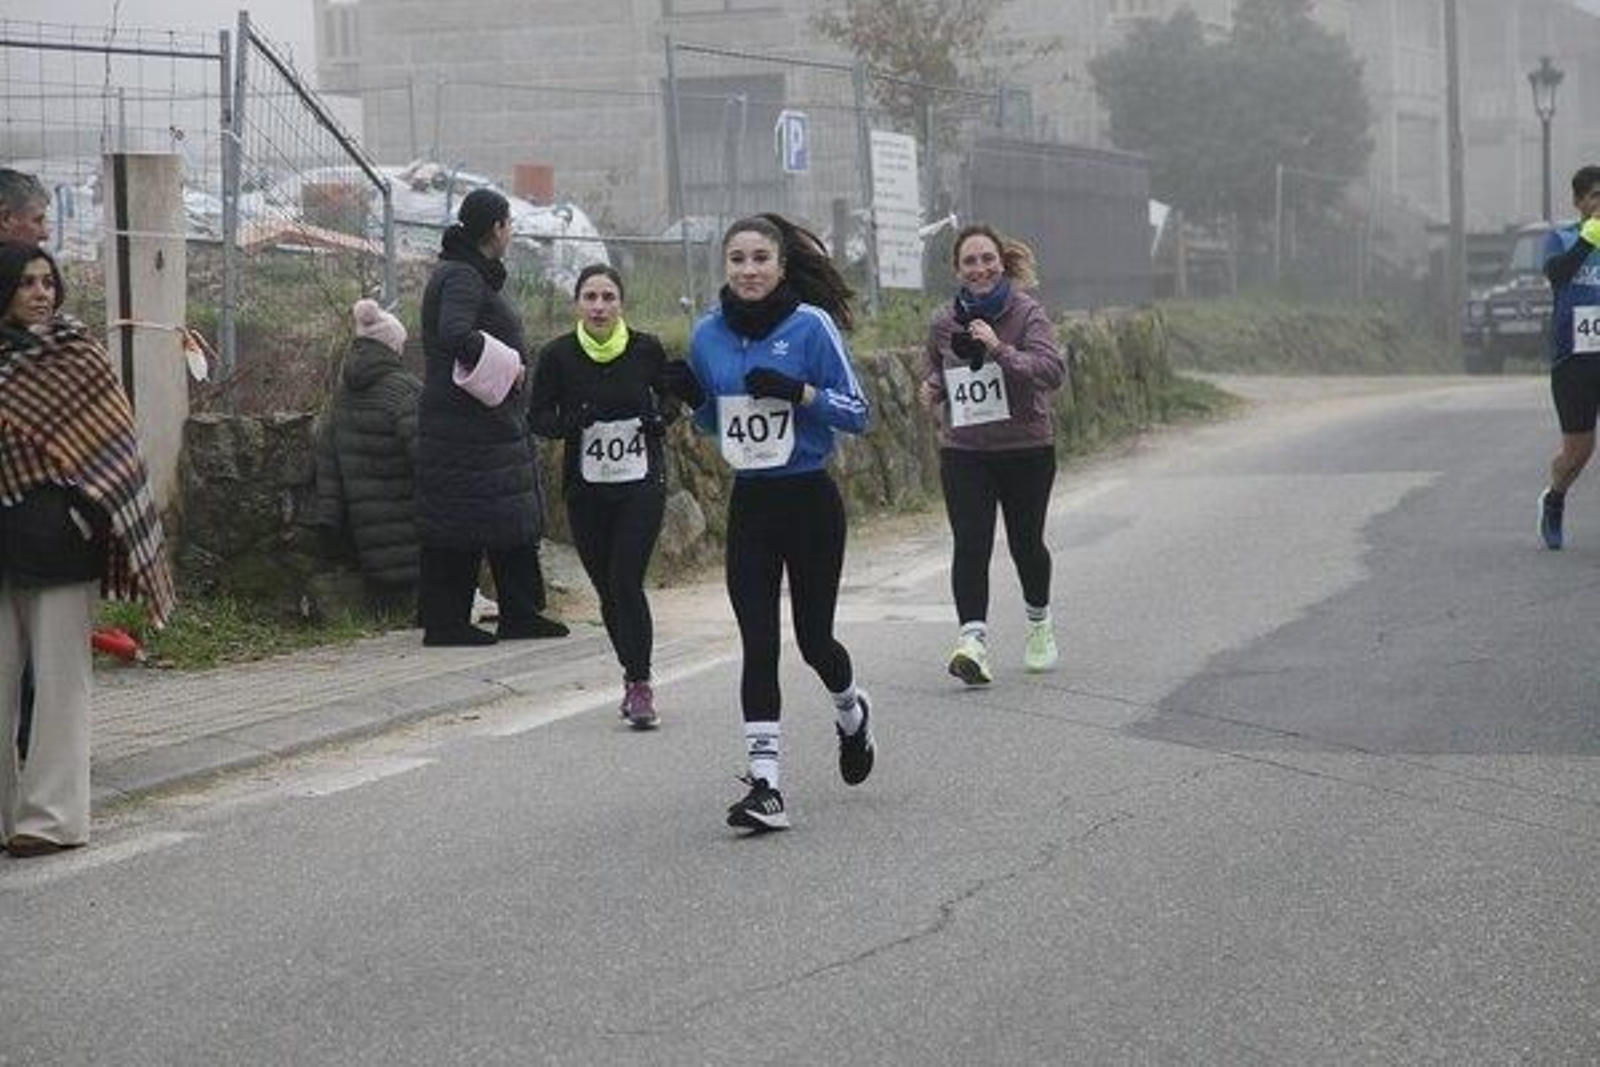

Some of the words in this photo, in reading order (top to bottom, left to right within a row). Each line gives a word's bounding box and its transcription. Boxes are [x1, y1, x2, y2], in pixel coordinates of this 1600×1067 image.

[789, 118, 803, 167] P
[955, 378, 1002, 405] 401
[727, 410, 789, 443] 407
[586, 433, 646, 461] 404
